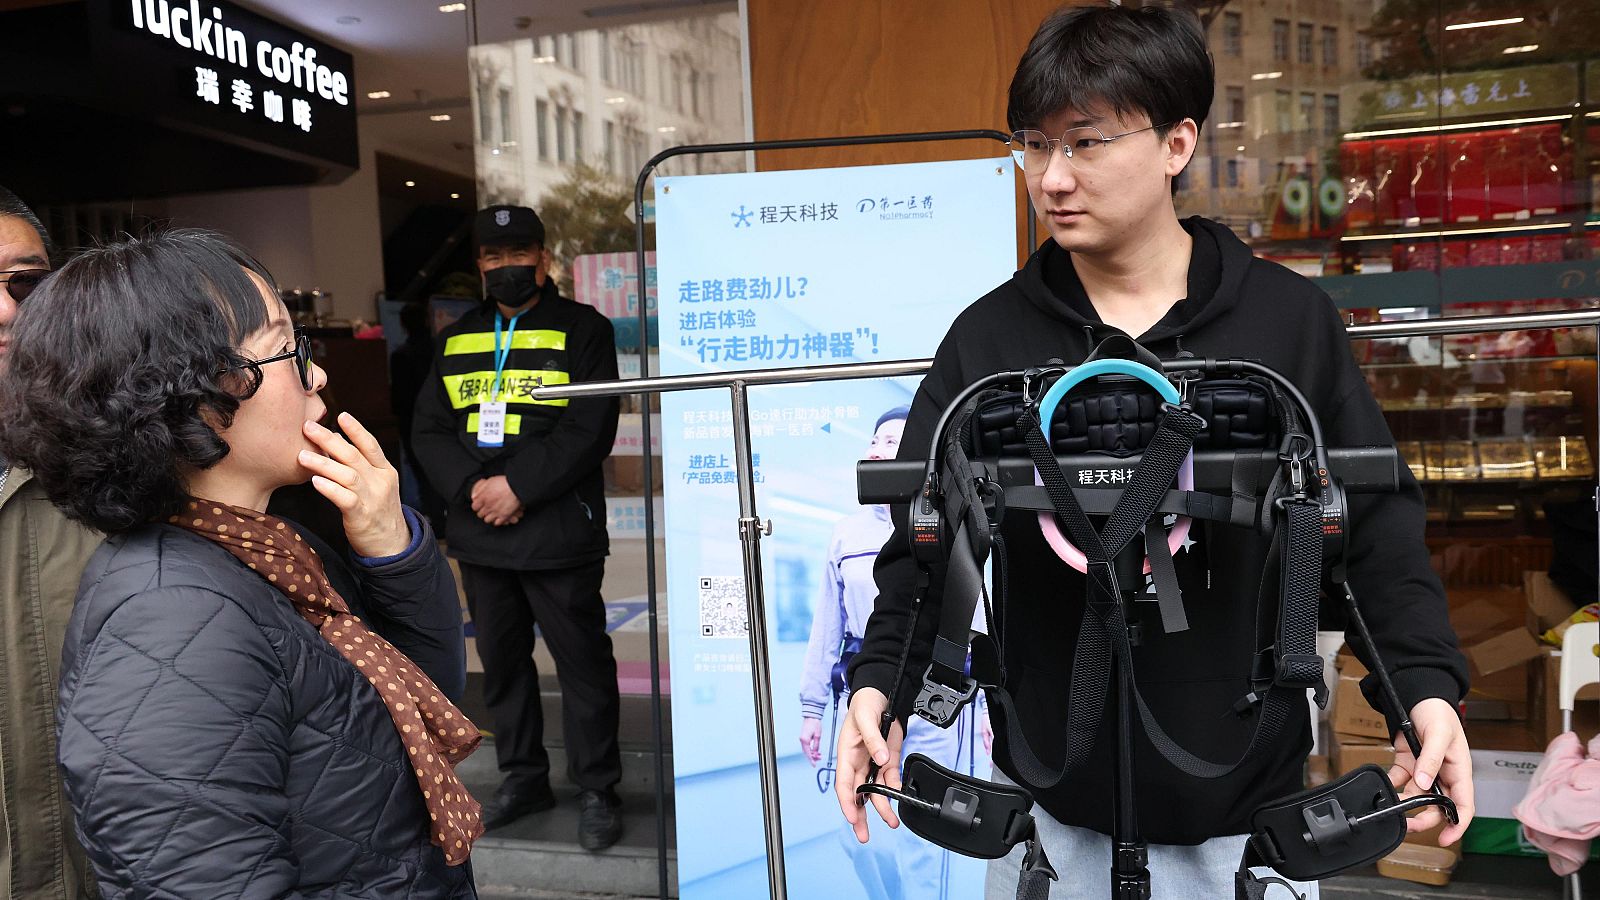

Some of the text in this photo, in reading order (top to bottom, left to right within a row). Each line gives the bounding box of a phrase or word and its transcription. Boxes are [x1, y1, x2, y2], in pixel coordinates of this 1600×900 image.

[256, 41, 349, 106] coffee
[195, 66, 312, 132] 瑞幸咖啡
[759, 195, 934, 225] 程天科技 第一医药
[678, 277, 809, 304] 走路费劲儿？
[679, 308, 756, 331] 进店体验
